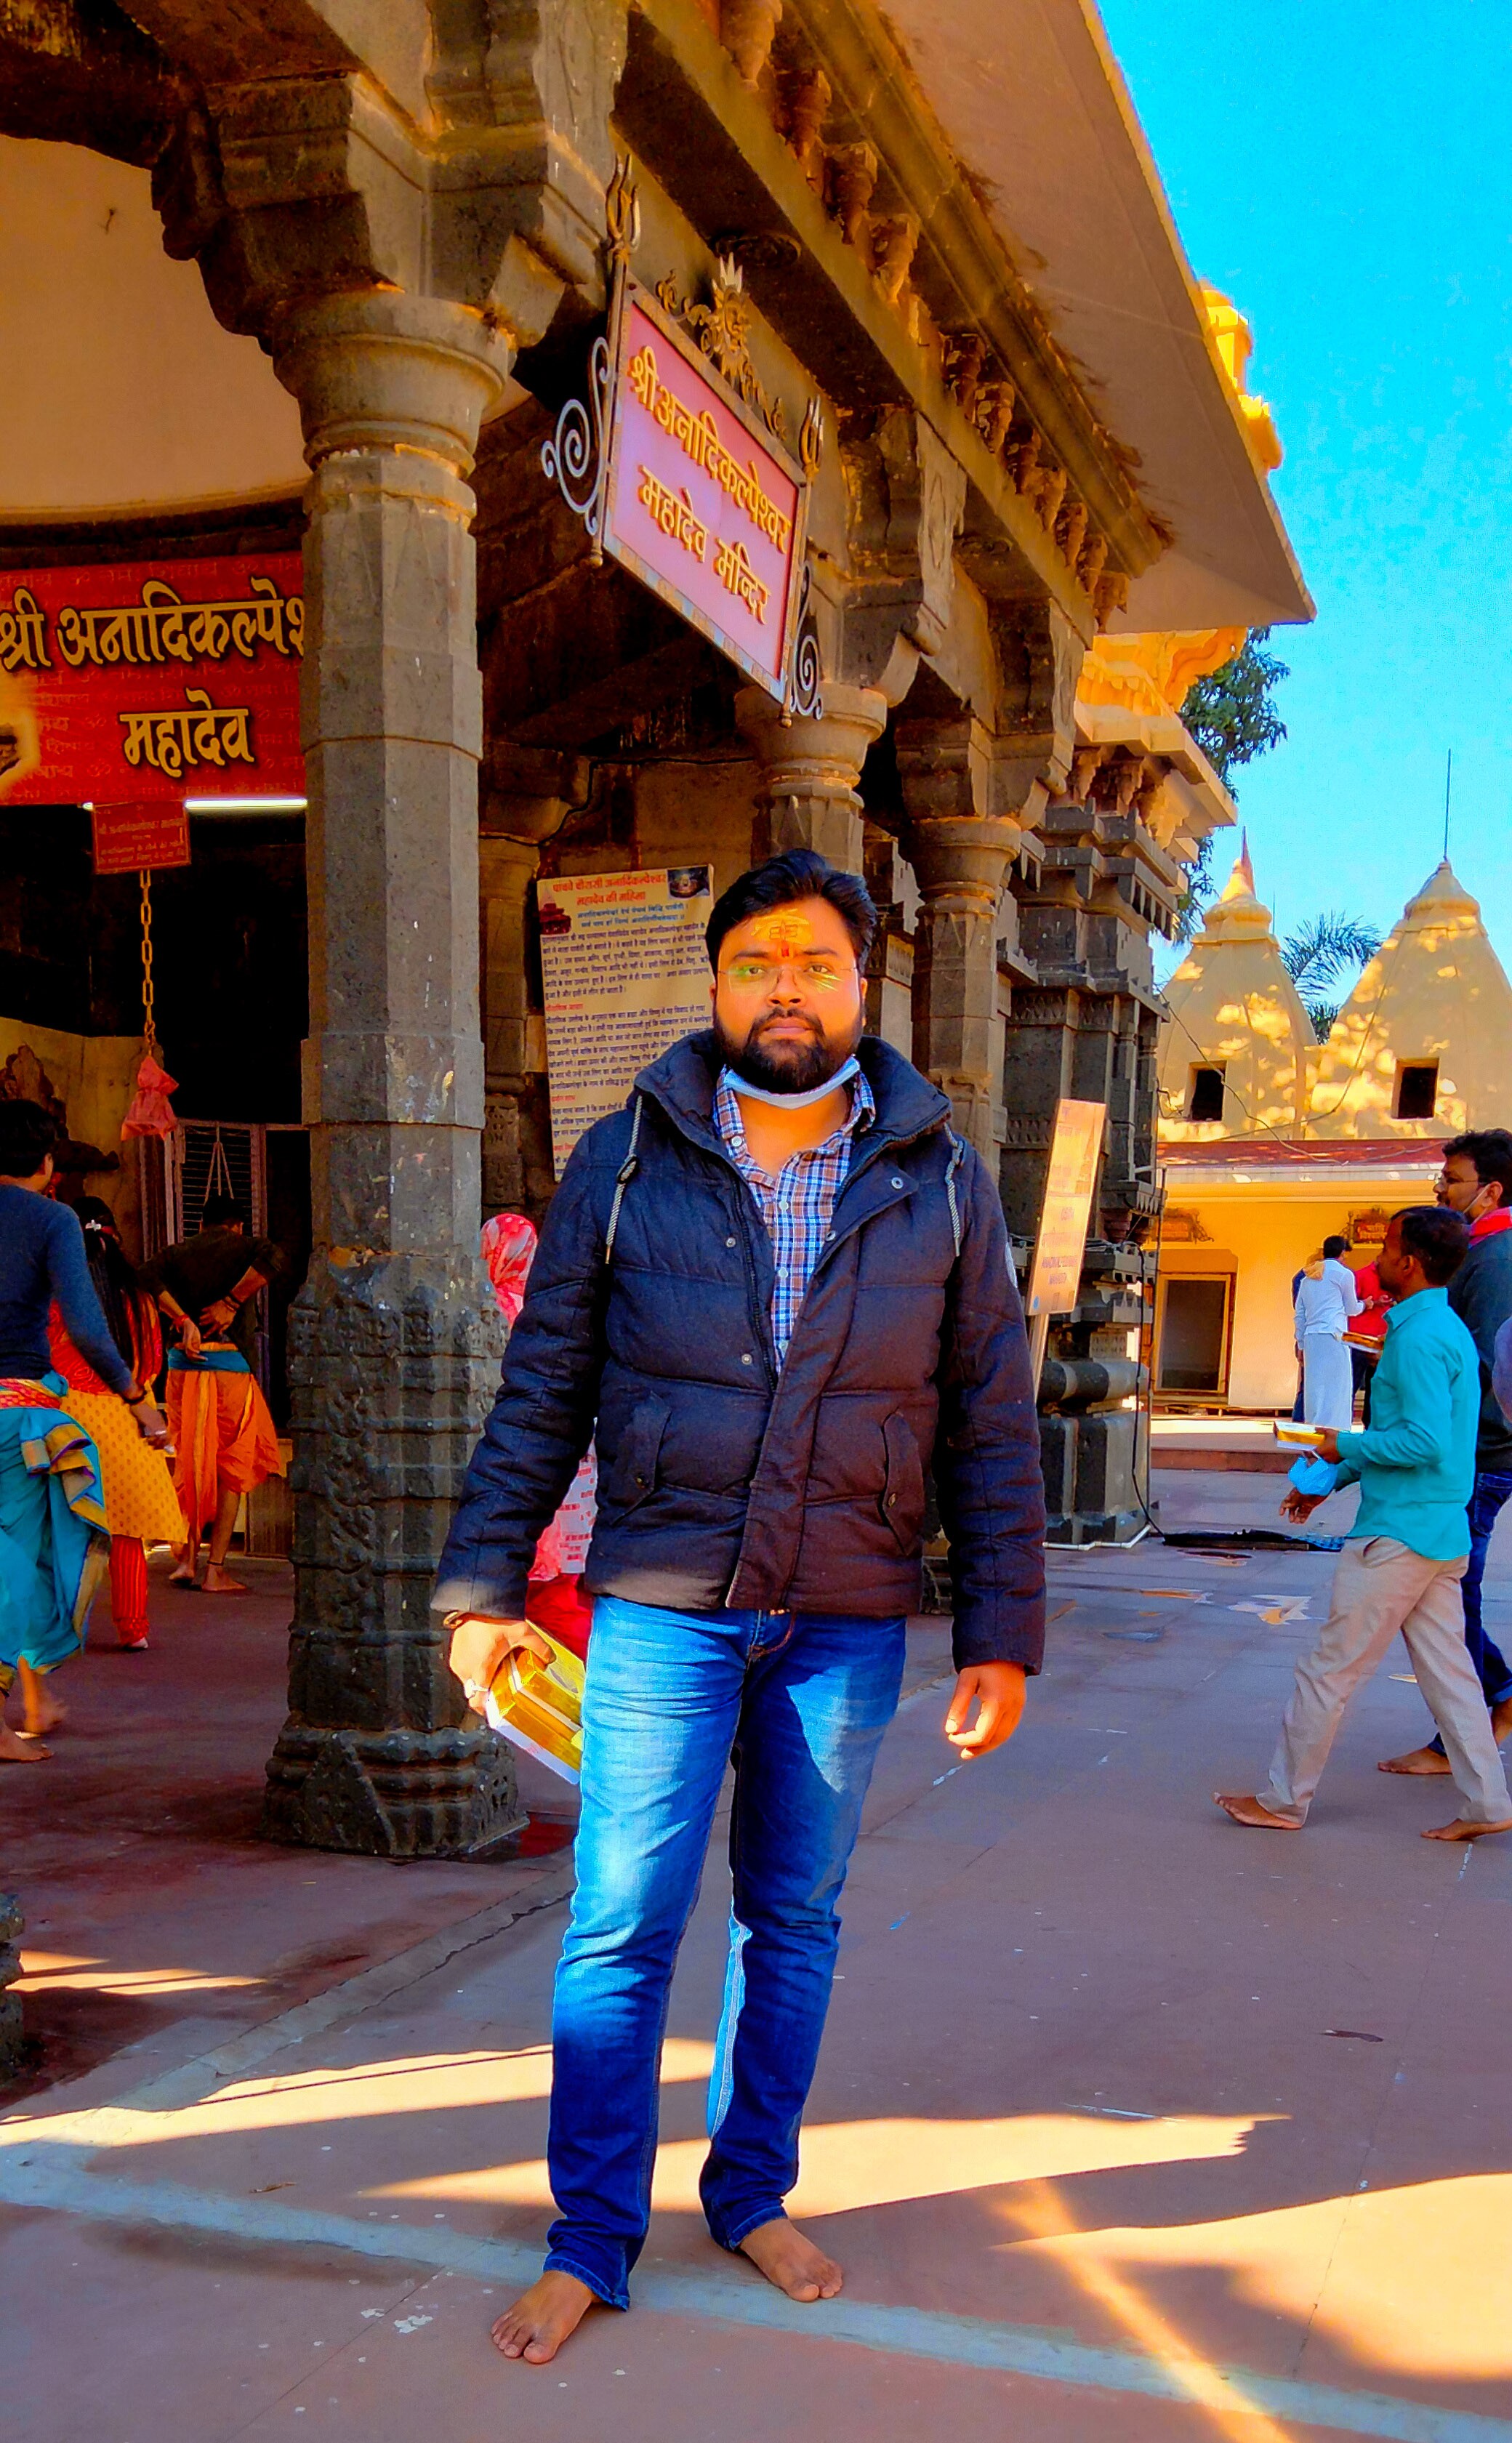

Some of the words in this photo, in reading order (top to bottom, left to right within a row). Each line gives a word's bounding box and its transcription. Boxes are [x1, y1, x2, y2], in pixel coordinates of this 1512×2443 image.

[638, 464, 710, 563] महादेव
[713, 537, 772, 626] मन्दिर
[0, 588, 52, 670] श्री
[119, 687, 255, 778] महादेव
